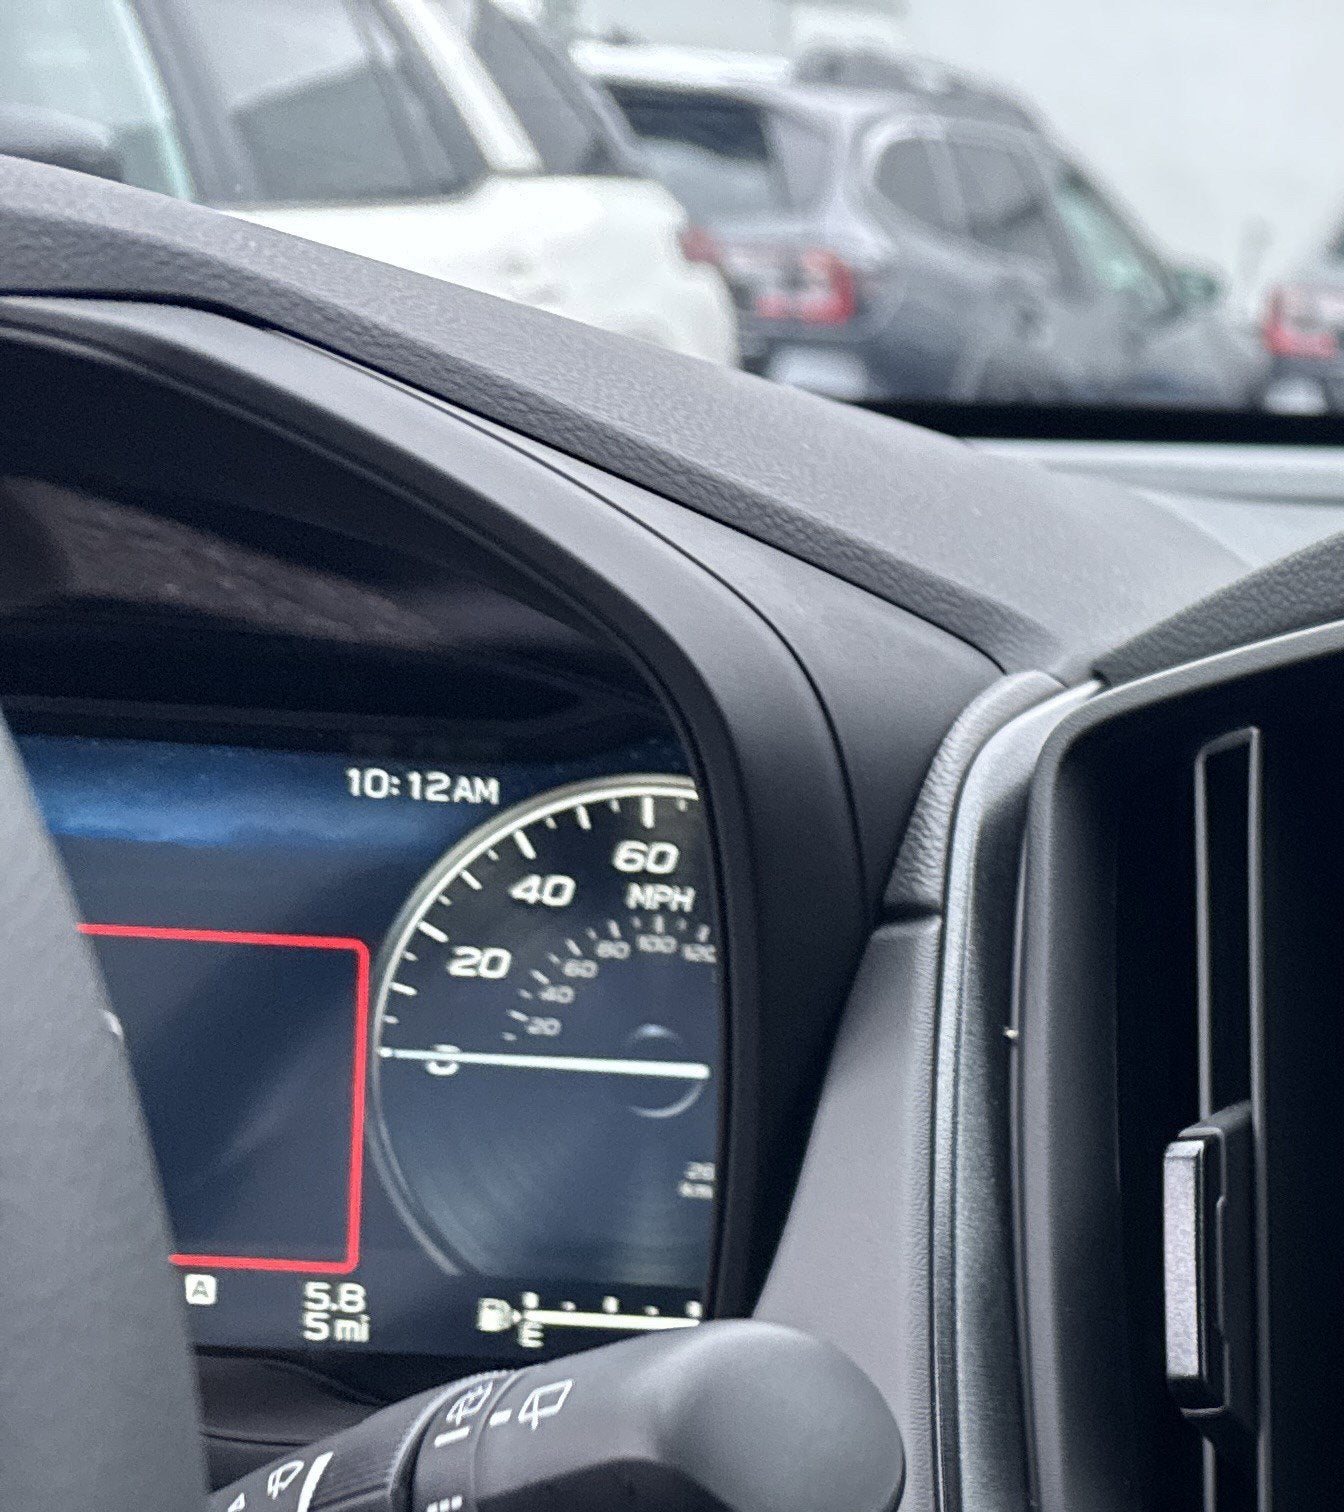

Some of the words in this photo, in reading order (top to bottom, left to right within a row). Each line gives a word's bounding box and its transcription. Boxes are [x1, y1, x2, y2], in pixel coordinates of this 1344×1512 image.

[612, 840, 680, 874] 60
[509, 874, 576, 907] 40
[625, 882, 696, 912] MPH
[446, 945, 512, 979] 20
[303, 1281, 366, 1312] 5.8
